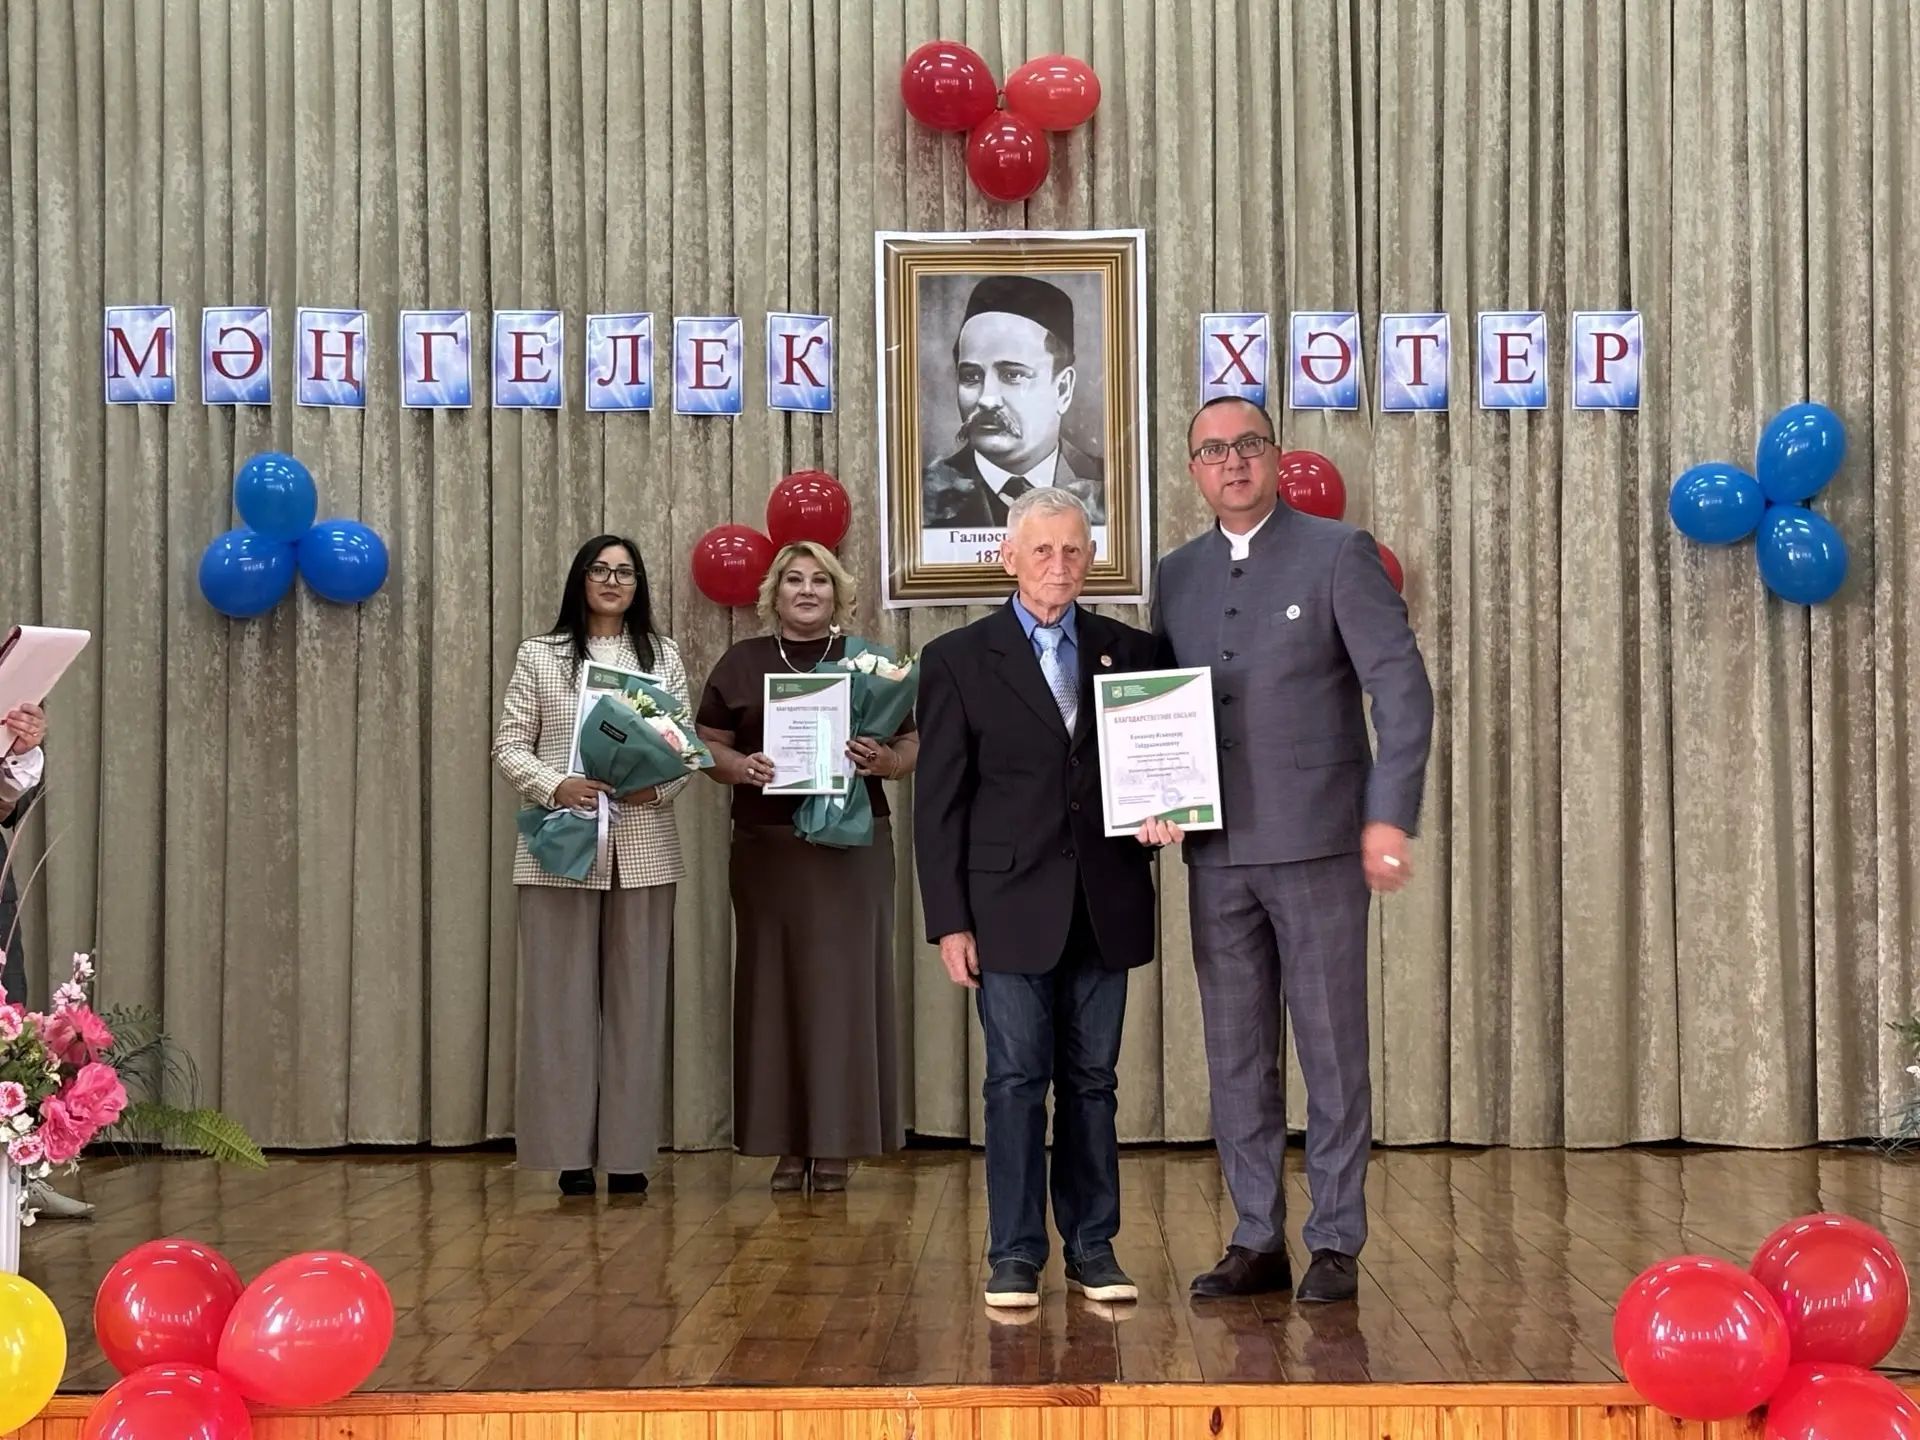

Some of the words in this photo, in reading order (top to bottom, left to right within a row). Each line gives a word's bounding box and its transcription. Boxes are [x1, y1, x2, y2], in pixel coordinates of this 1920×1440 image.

[107, 327, 825, 398] МӘҢГЕЛЕК
[1210, 332, 1629, 385] ХӘТЕР
[949, 530, 1008, 543] Галиәсг
[976, 550, 1001, 563] 187
